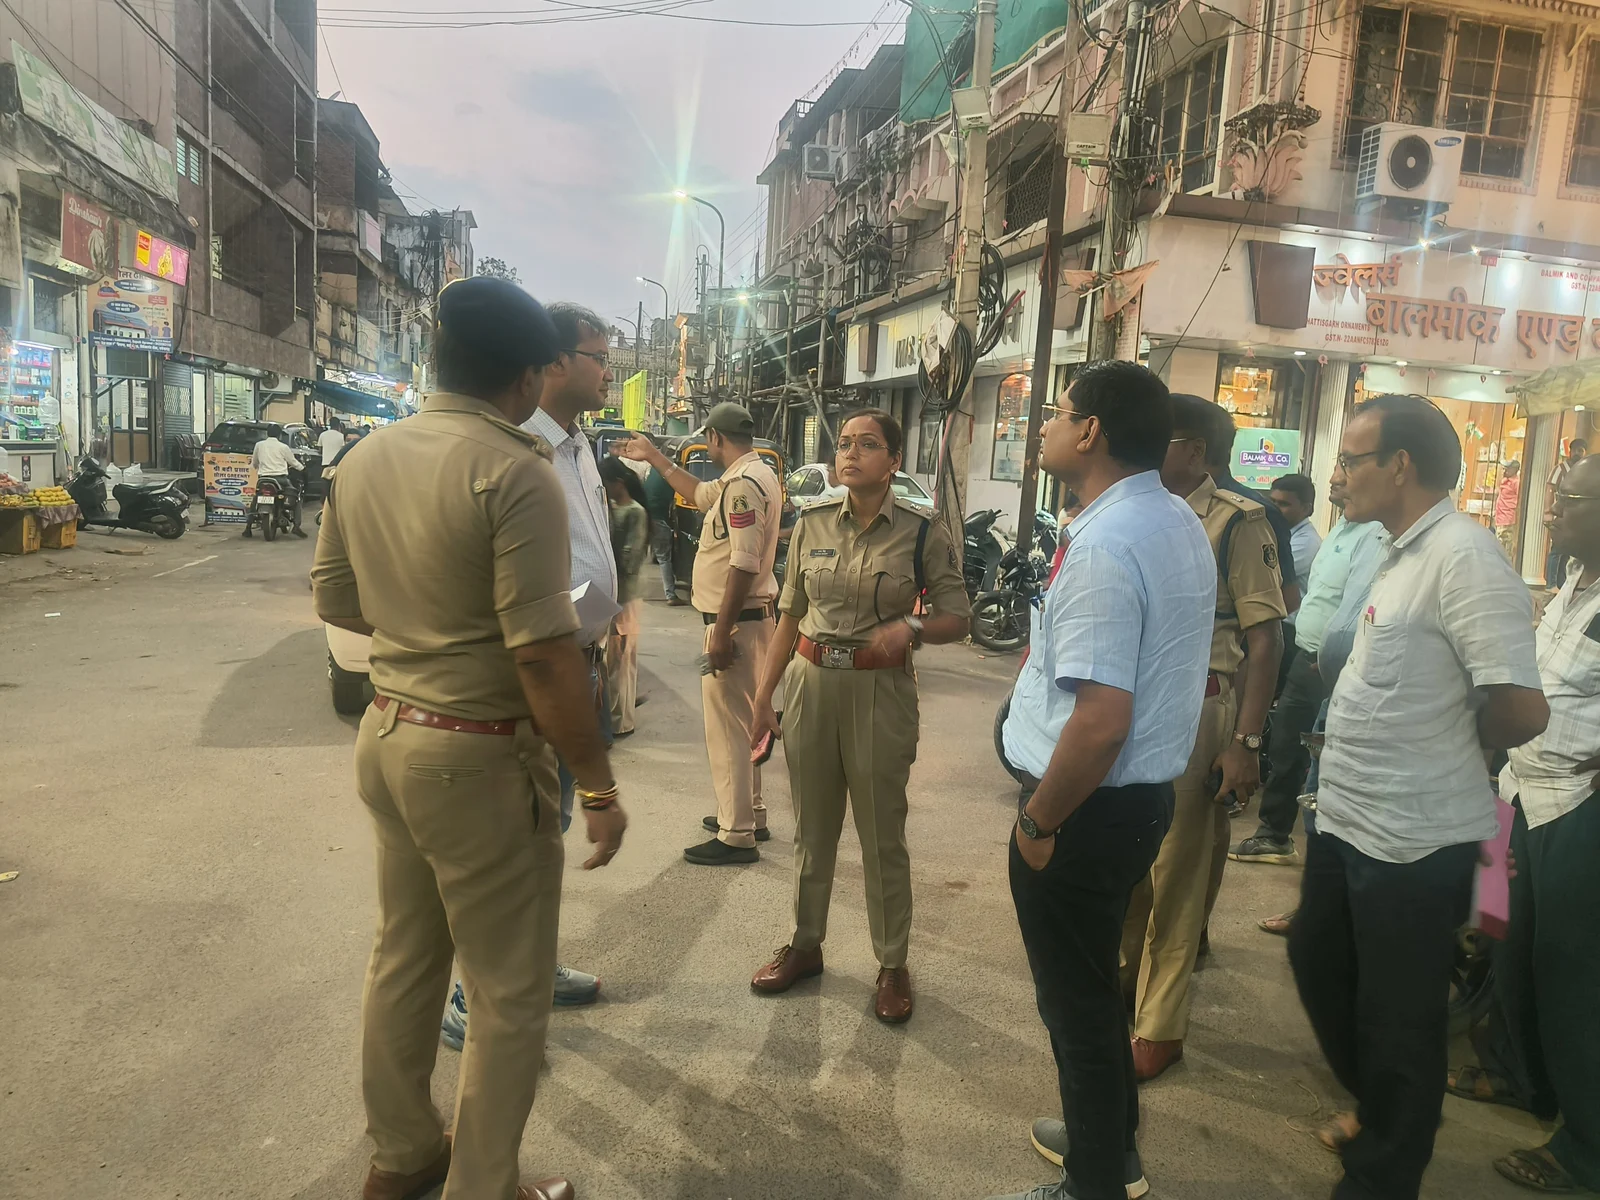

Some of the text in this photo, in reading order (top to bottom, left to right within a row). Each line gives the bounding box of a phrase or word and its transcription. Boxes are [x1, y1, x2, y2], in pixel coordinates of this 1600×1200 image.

[1541, 269, 1563, 278] BALMIK
[1566, 272, 1578, 280] AND
[1340, 320, 1371, 332] ORNAMENTS
[1366, 287, 1506, 344] बालमीक
[1517, 310, 1586, 359] एण्ड
